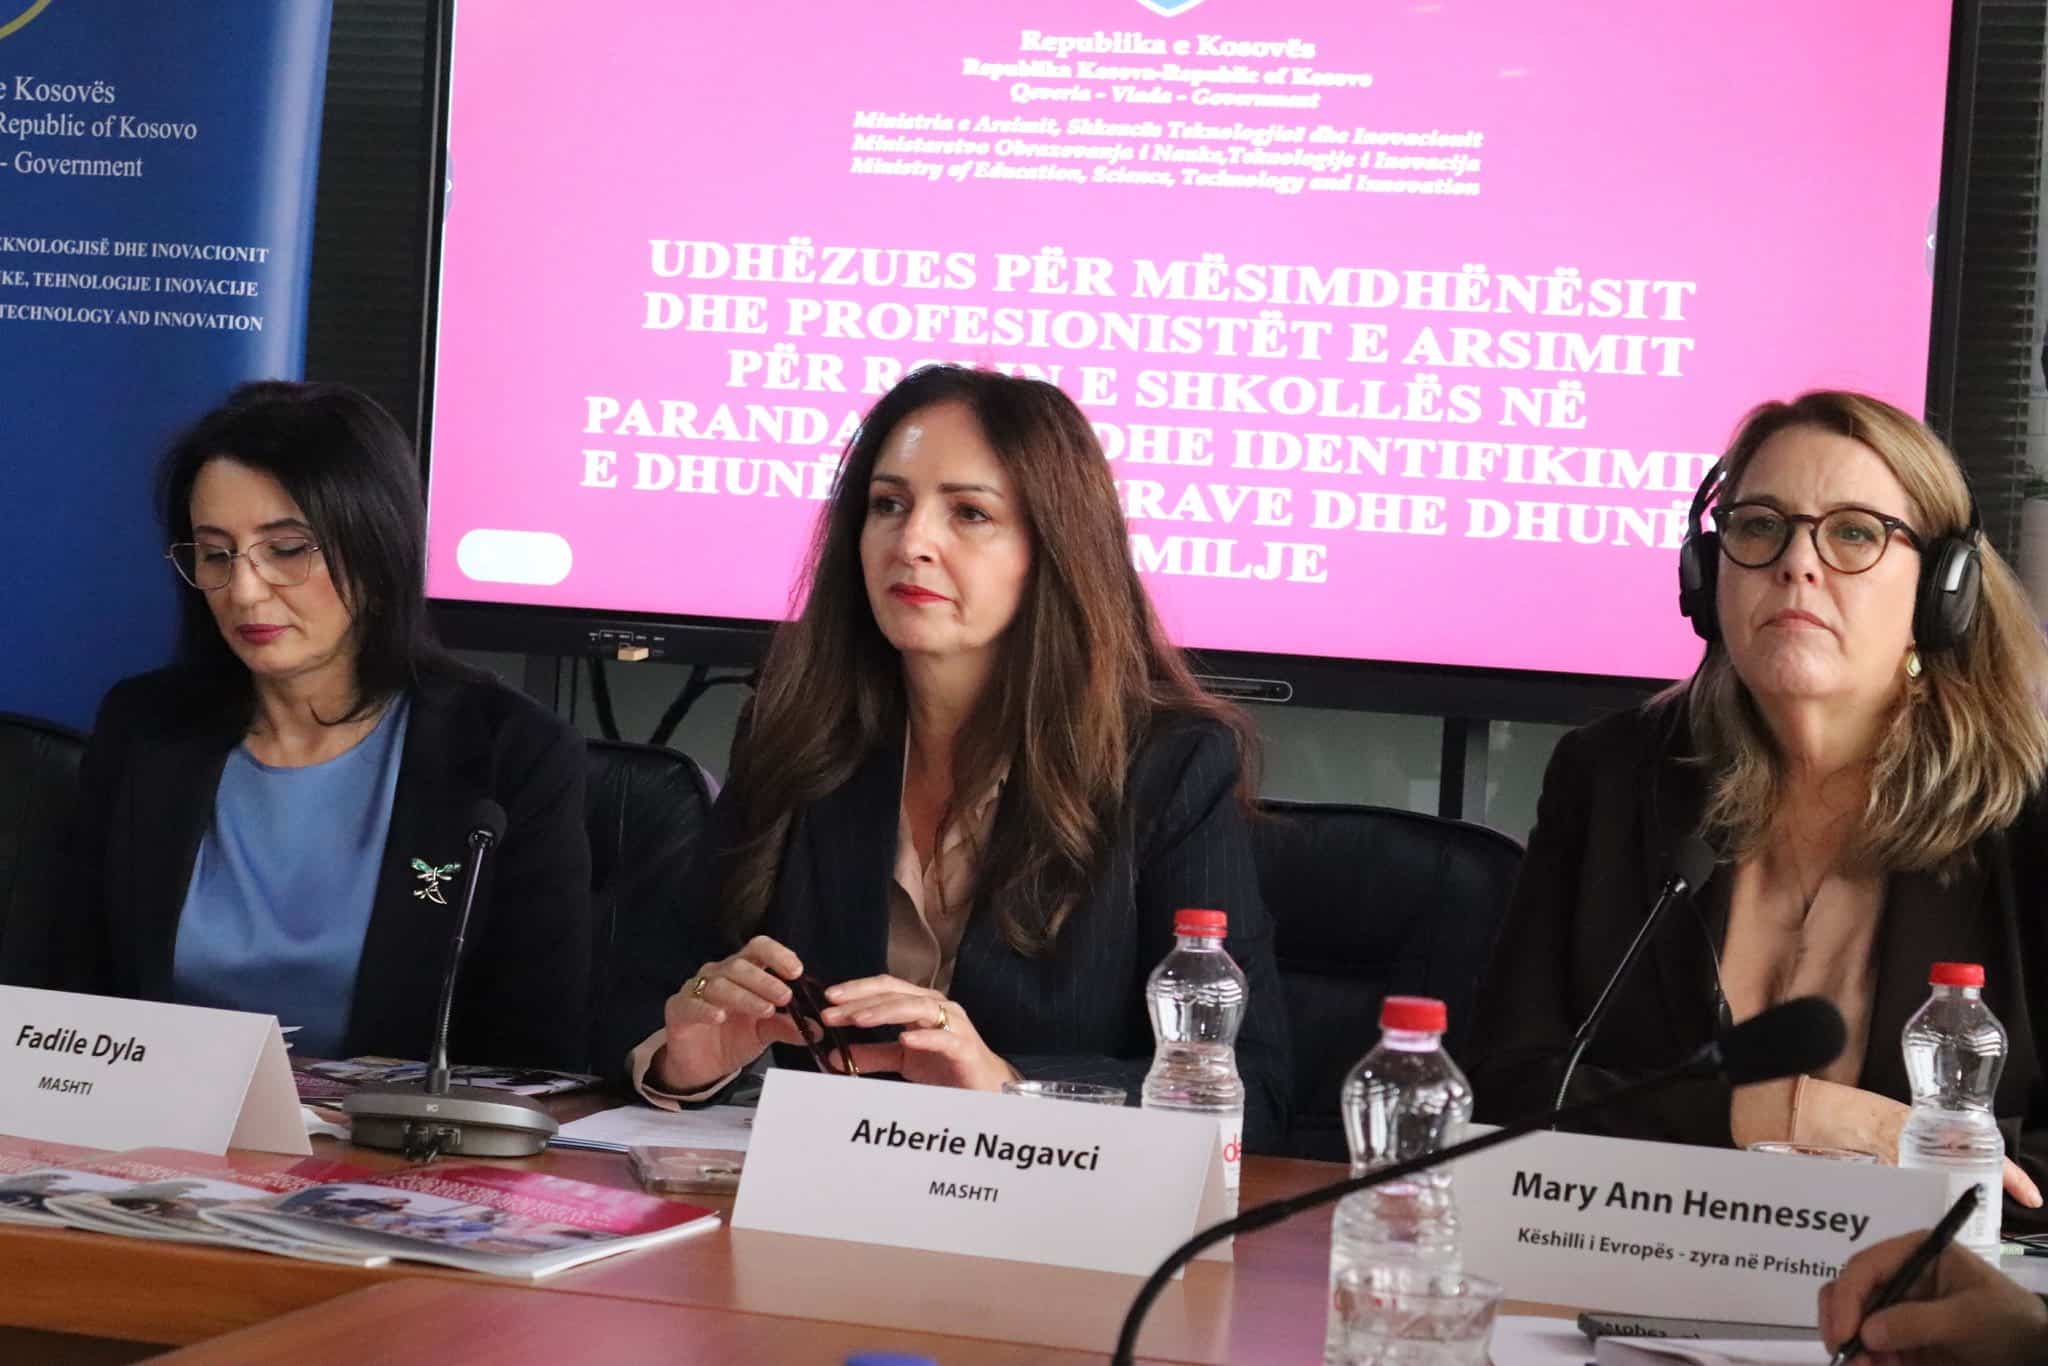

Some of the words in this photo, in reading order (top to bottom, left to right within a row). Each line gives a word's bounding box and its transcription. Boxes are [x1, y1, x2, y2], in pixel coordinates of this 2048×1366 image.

[1020, 30, 1167, 58] Republika
[1173, 39, 1190, 55] e
[1196, 34, 1317, 59] Kosovës
[962, 58, 1073, 81] Republika
[1263, 67, 1289, 84] of
[1291, 67, 1373, 88] Kosovo
[15, 76, 115, 103] Kosovës
[1010, 82, 1092, 104] Qeveria
[1111, 85, 1173, 104] Vlada
[1191, 87, 1321, 109] Government
[91, 115, 116, 137] of
[119, 116, 197, 140] Kosovo
[853, 111, 954, 131] Ministria
[1308, 125, 1349, 144] dhe
[15, 151, 143, 177] Government
[850, 157, 944, 181] Ministry
[948, 159, 974, 182] of
[1181, 168, 1305, 195] Technology
[1309, 173, 1353, 191] and
[1356, 174, 1480, 196] Innovation
[114, 242, 148, 258] DHE
[152, 243, 269, 264] INOVACIONIT
[34, 271, 150, 292] TEHNOLOGIJE
[155, 276, 161, 291] I
[165, 277, 259, 297] INOVACIJE
[649, 237, 977, 290] UDHËZUES
[993, 246, 1117, 297] PËR
[1132, 253, 1697, 321] MËSIMDHËNËSIT
[117, 310, 150, 327] AND
[154, 311, 264, 332] INNOVATION
[642, 292, 768, 334] DHE
[786, 299, 1332, 361] PROFESIONISTËT
[1348, 323, 1389, 363] E
[1403, 326, 1695, 377] ARSIMIT
[727, 342, 847, 393] PËR
[1079, 366, 1118, 406] E
[1135, 368, 1482, 424] SHKOLLËS
[1499, 379, 1588, 430] NË
[1091, 421, 1214, 467] DHE
[581, 450, 617, 488] E
[1310, 489, 1447, 535] DHE
[16, 1024, 87, 1055] Fadile
[91, 1034, 146, 1064] Dyla
[38, 1076, 93, 1095] MASHTI
[851, 1118, 966, 1156] Arberie
[974, 1132, 1101, 1171] Nagavci
[929, 1180, 999, 1203] MASHTI
[1512, 1171, 1598, 1212] Mary
[1605, 1180, 1673, 1215] Ann
[1682, 1189, 1870, 1242] Hennessey
[1517, 1227, 1585, 1251] Këshilli
[1589, 1237, 1597, 1252] i
[1599, 1236, 1675, 1262] Evropës
[1689, 1249, 1730, 1268] zyra
[1735, 1252, 1760, 1270] në
